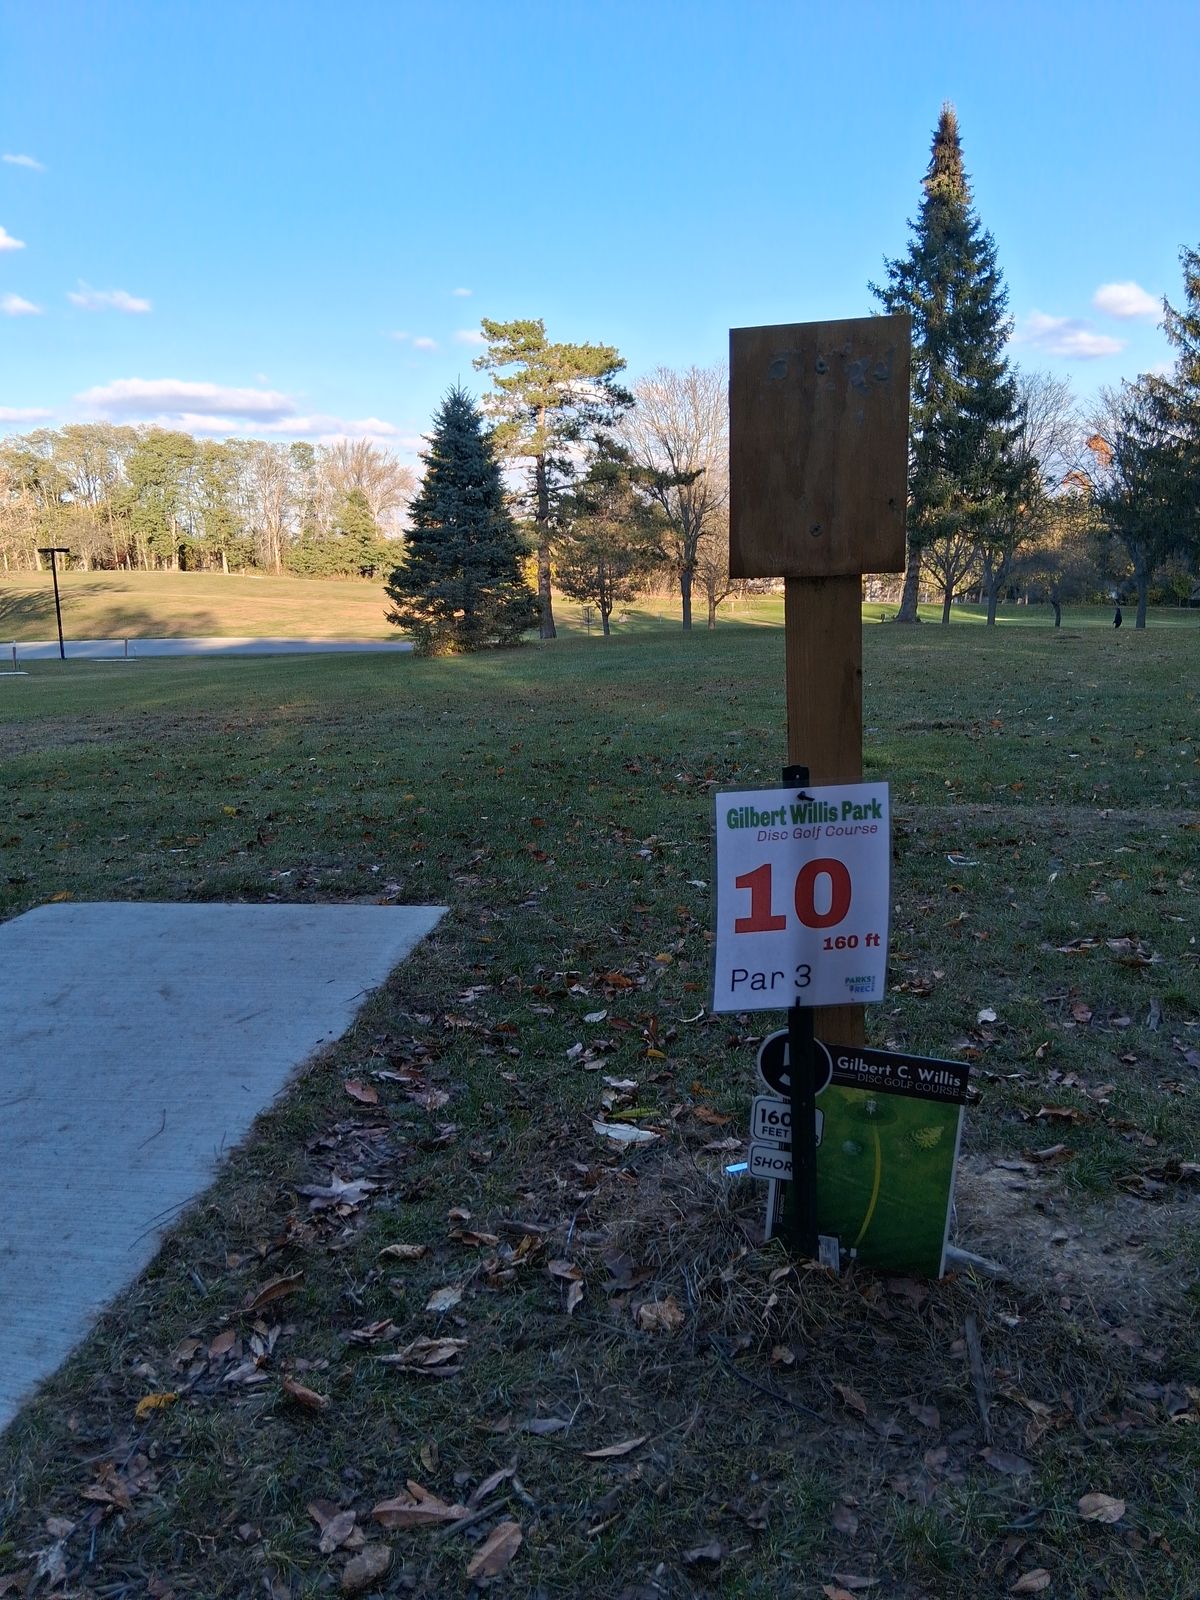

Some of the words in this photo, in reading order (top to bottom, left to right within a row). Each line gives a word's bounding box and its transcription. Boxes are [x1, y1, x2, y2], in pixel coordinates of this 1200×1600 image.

[726, 805, 787, 829] Gilbert
[789, 801, 838, 825] Willis
[841, 798, 883, 821] Park
[757, 830, 788, 842] Disc
[792, 826, 821, 841] Golf
[825, 824, 878, 837] Course
[735, 857, 852, 933] 10
[823, 934, 859, 950] 160
[865, 932, 881, 948] ft
[731, 968, 785, 992] Par
[794, 964, 812, 988] 3
[845, 975, 872, 984] PARKS
[837, 1056, 892, 1076] Gilbert
[897, 1065, 912, 1079] C.
[918, 1068, 961, 1087] Willis
[857, 1073, 881, 1085] DISC
[884, 1077, 914, 1089] GOLF
[915, 1081, 960, 1097] COURSE
[761, 1108, 792, 1127] 160
[761, 1125, 790, 1139] FEET
[753, 1155, 793, 1173] SHOR
